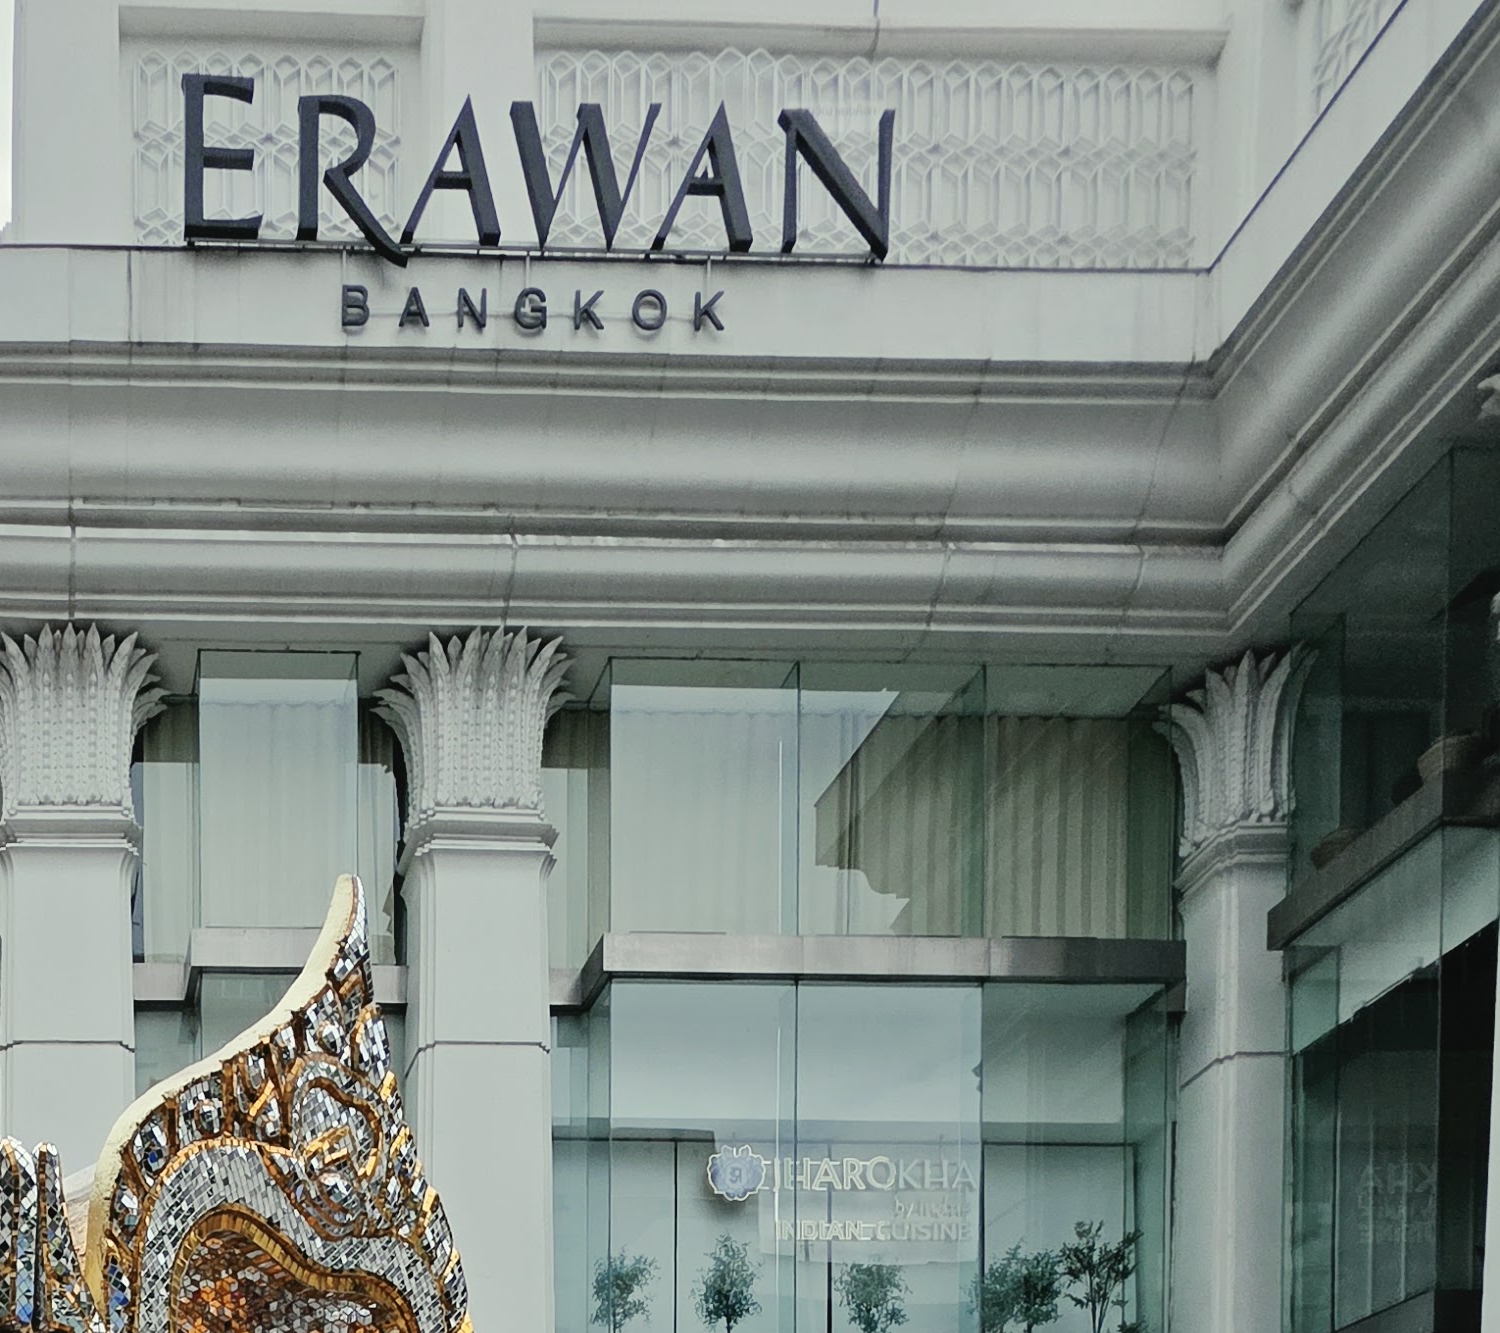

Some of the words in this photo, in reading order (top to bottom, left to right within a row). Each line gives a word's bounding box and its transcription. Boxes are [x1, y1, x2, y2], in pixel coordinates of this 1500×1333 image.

[181, 73, 896, 267] ERAWAN
[341, 284, 725, 331] BANGKOK
[773, 1156, 977, 1192] JHAROKHA
[777, 1220, 864, 1241] INDIAN
[876, 1219, 972, 1241] CUISINE
